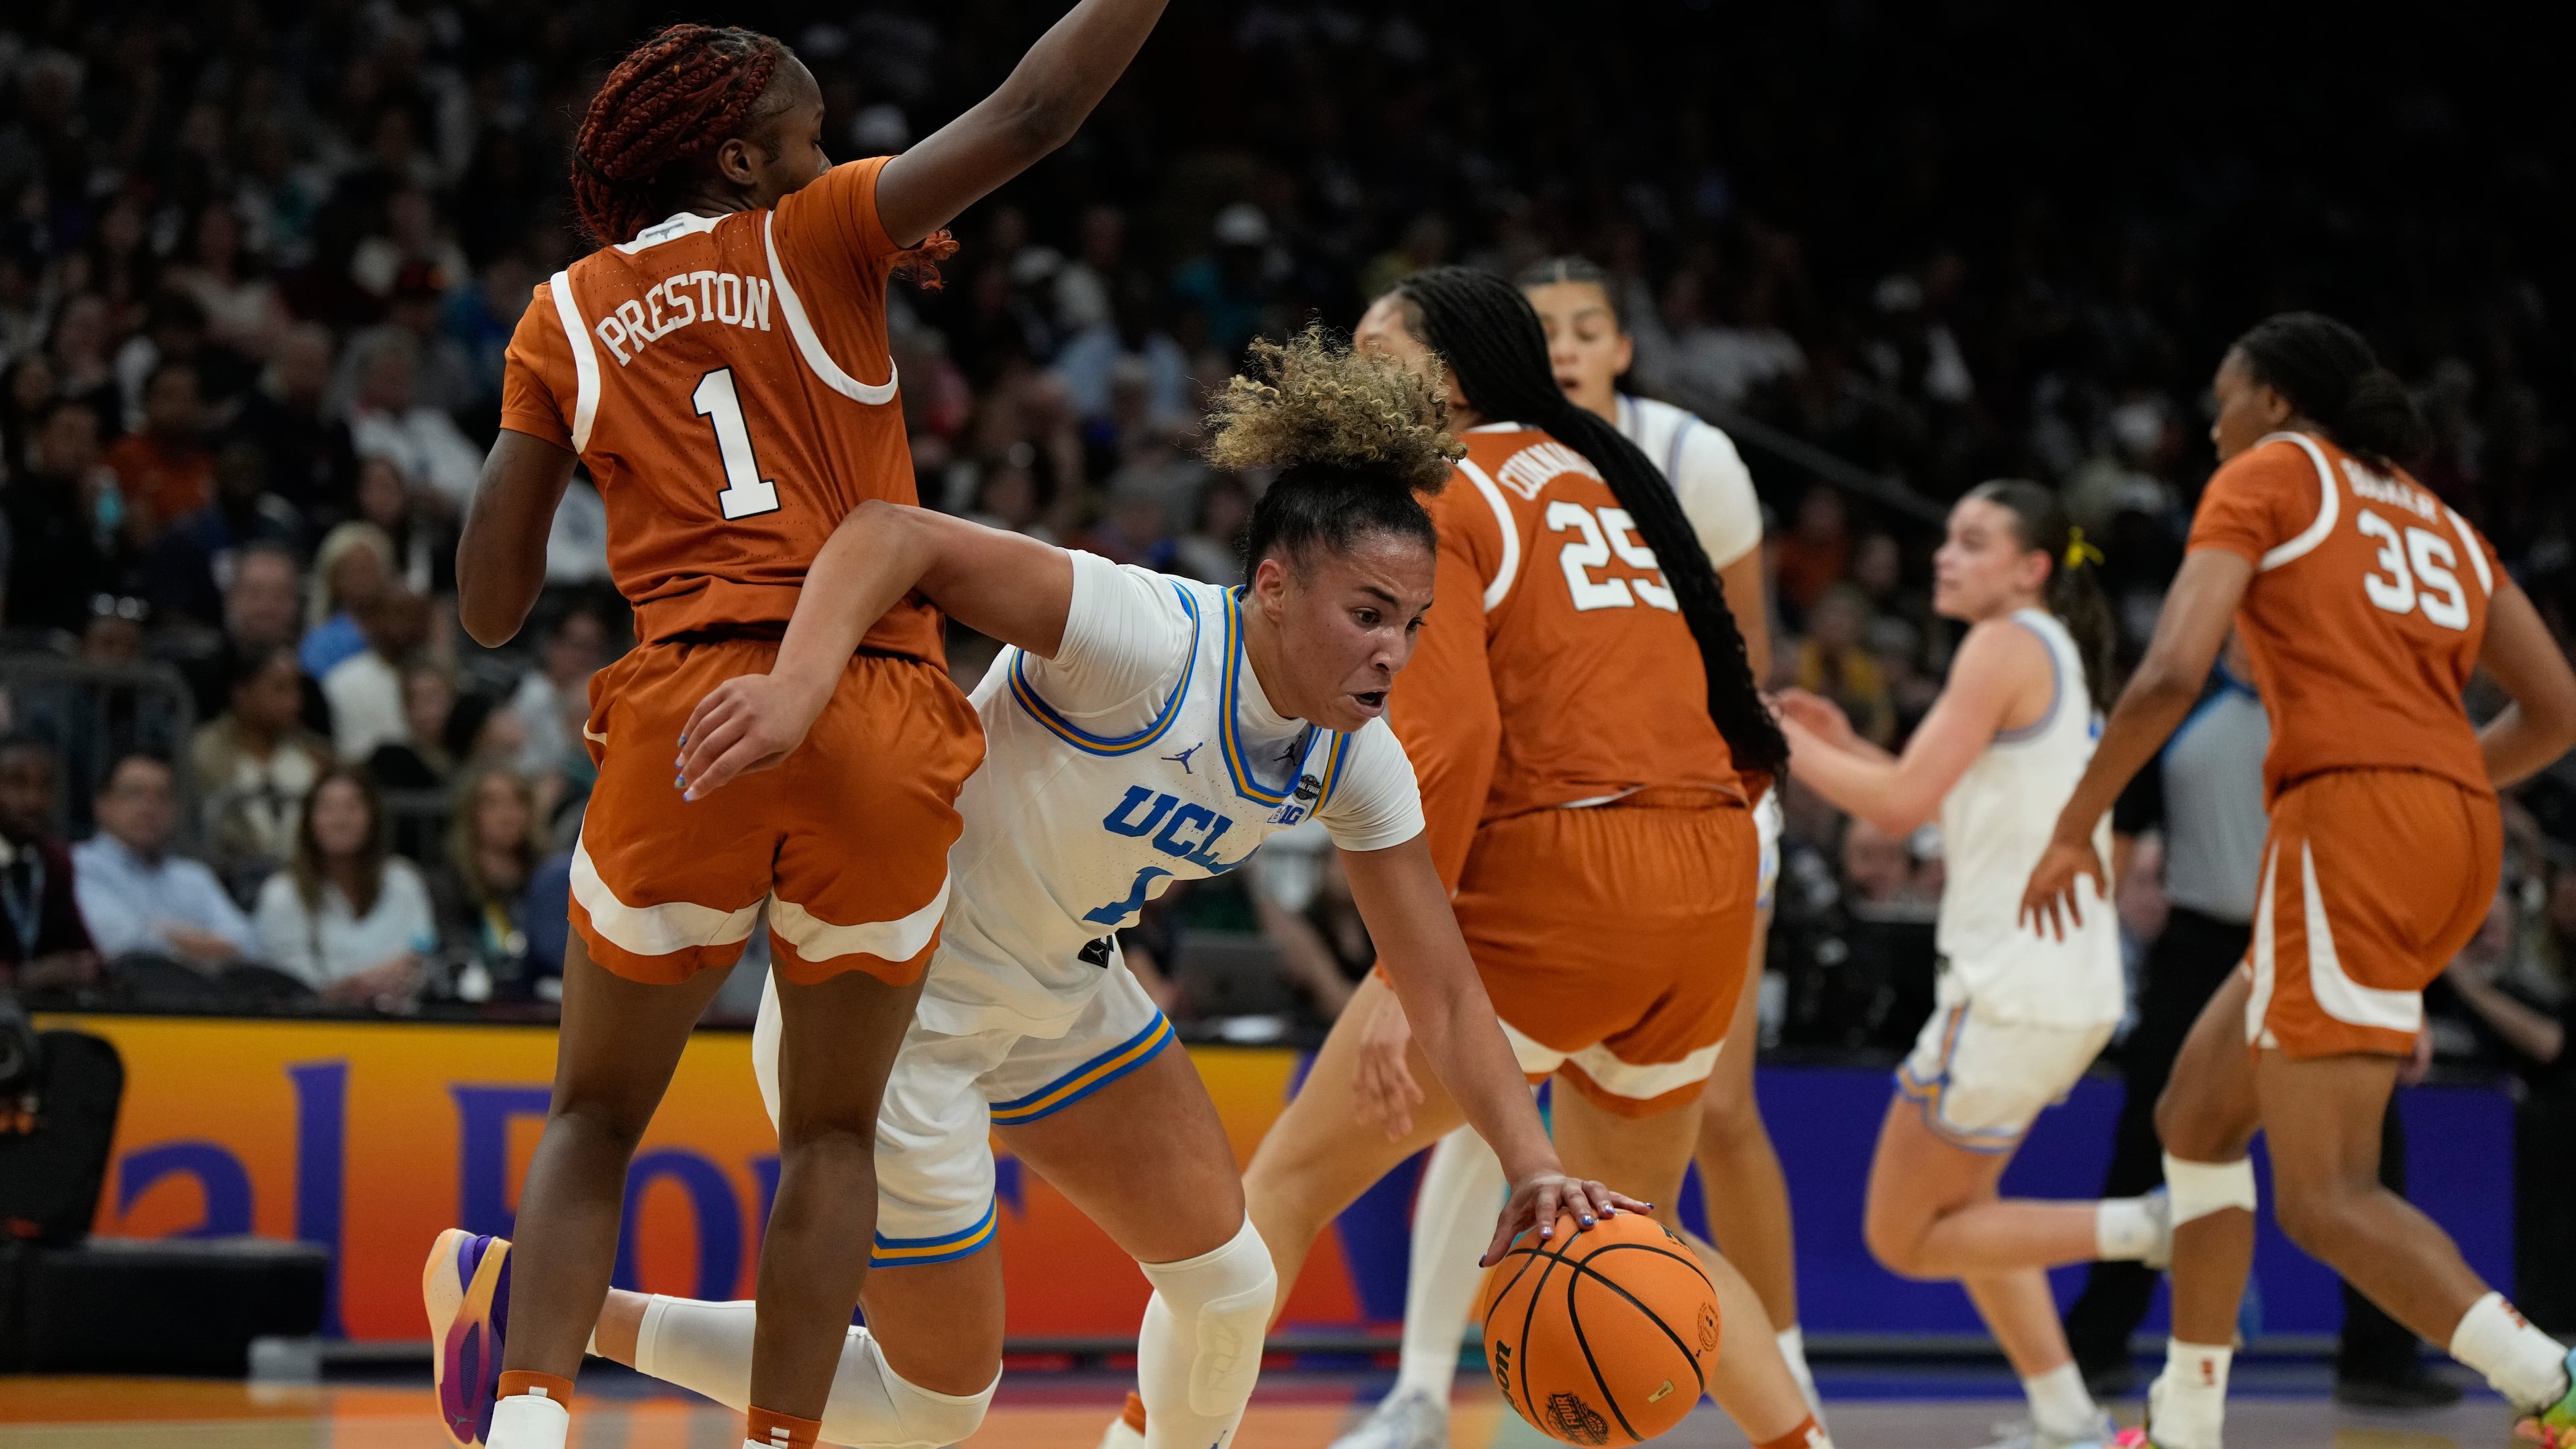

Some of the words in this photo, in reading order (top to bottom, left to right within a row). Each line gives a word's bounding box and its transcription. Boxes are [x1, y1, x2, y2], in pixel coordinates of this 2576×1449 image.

[596, 270, 771, 368] PRESTON
[690, 366, 782, 521] 1
[1546, 500, 1680, 613] 25
[2357, 508, 2470, 631] 35
[1307, 785, 1321, 795] FOUR
